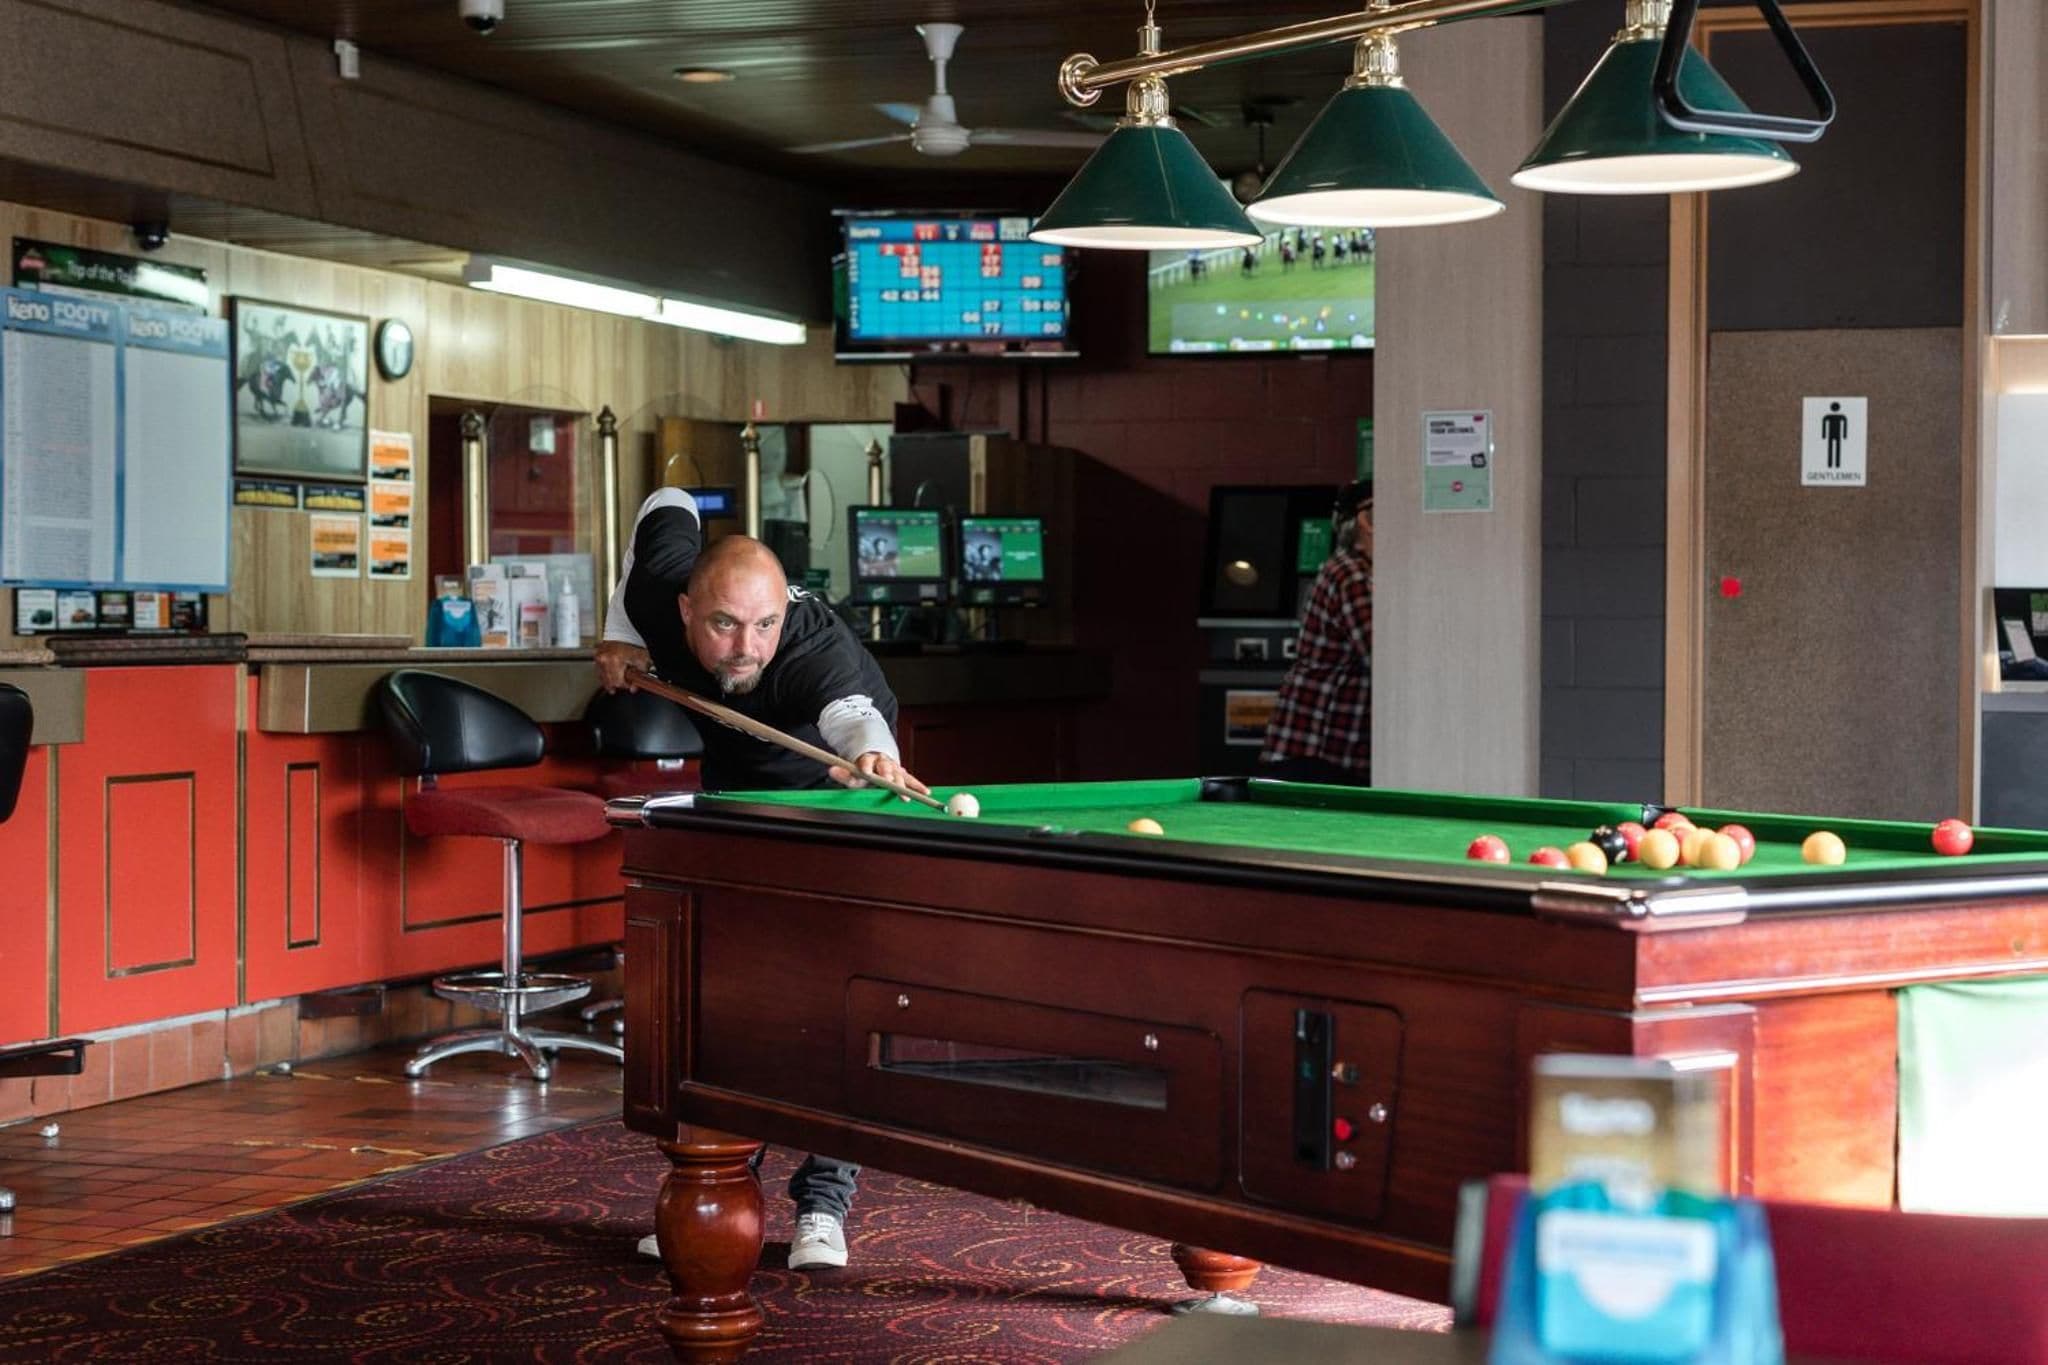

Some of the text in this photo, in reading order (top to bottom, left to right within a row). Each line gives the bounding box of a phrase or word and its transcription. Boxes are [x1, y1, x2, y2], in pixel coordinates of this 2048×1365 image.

[8, 296, 49, 321] keno
[53, 301, 109, 326] FOOTY
[129, 315, 223, 342] keno FOOTY
[1807, 472, 1861, 480] GENTLEMEN
